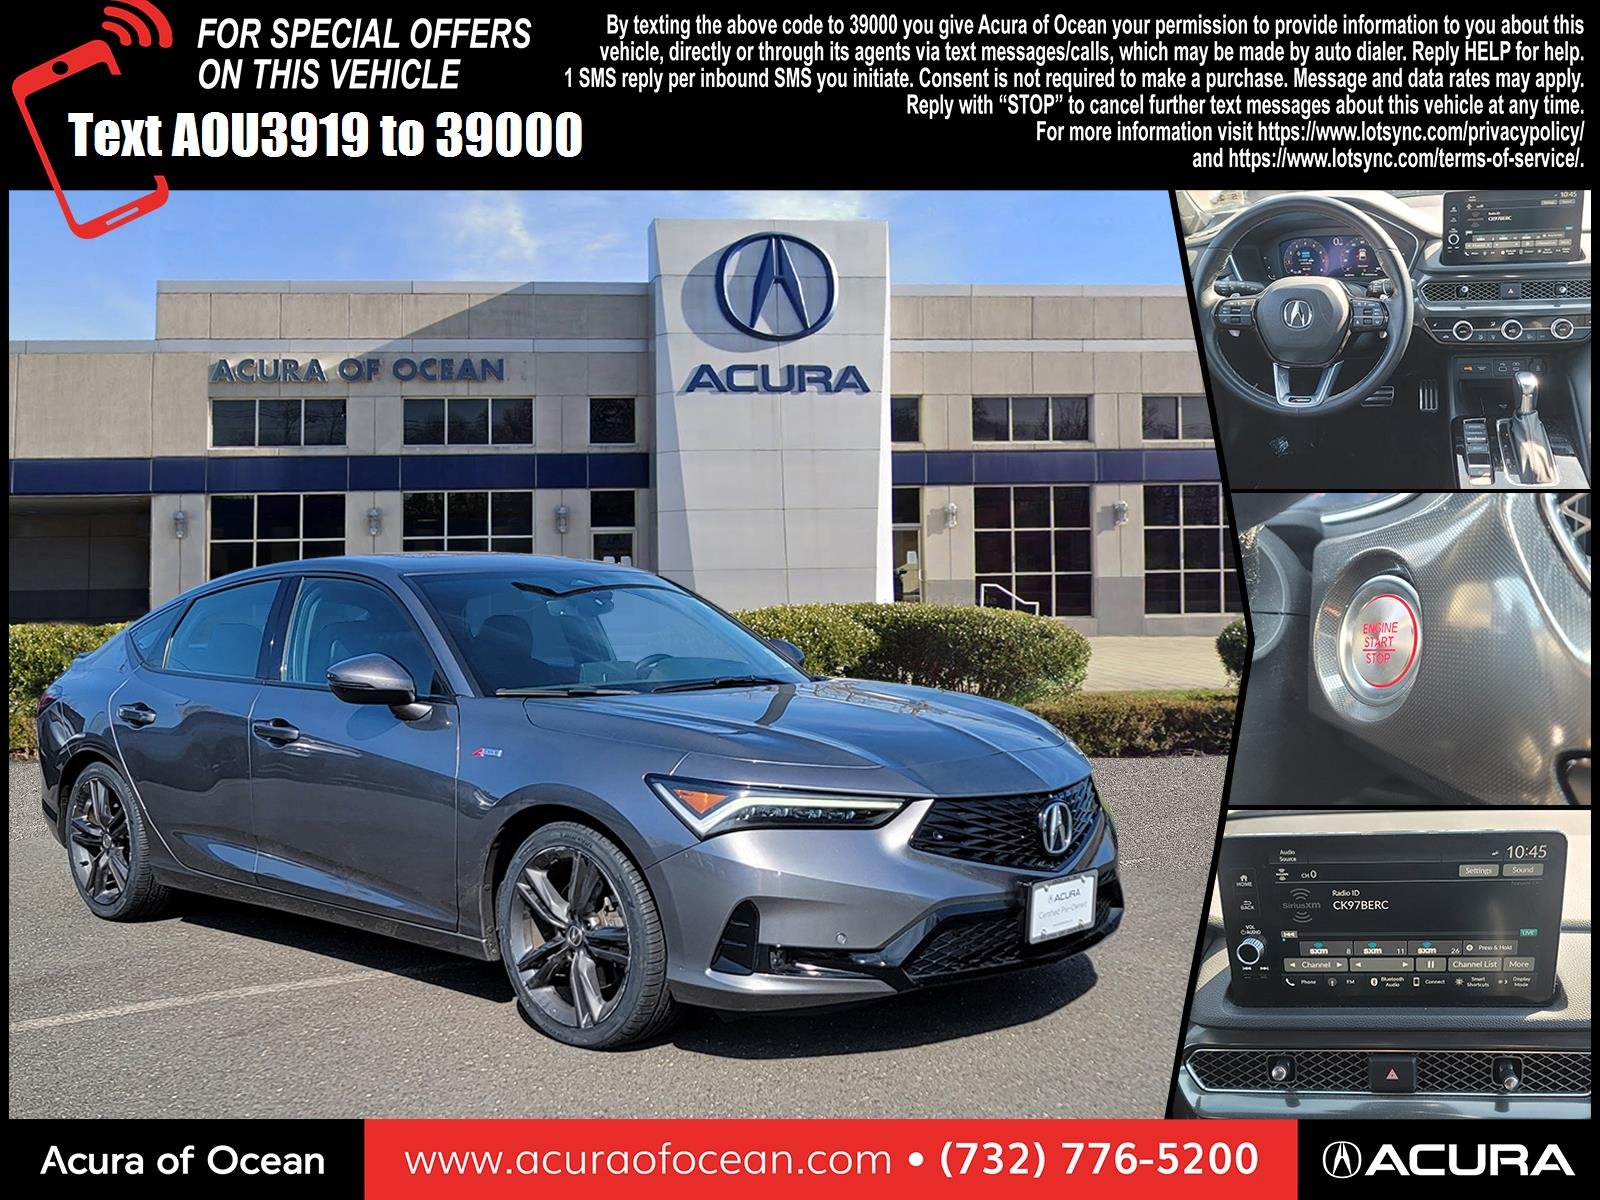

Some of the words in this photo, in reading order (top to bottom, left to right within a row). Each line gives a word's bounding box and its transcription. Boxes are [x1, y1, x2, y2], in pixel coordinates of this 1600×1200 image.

[209, 358, 327, 384] ACURA
[338, 357, 380, 383] OF
[392, 357, 505, 383] OCEAN
[685, 363, 871, 394] ACURA
[1363, 622, 1398, 634] ENGINE
[1364, 636, 1394, 648] START
[1366, 653, 1390, 665] STOP
[1507, 845, 1548, 859] 10:45
[1465, 867, 1493, 875] Settings
[1512, 866, 1534, 874] Sound
[1054, 888, 1081, 902] ACURA
[1351, 889, 1361, 897] ID
[1332, 900, 1390, 910] CK97BERC
[1301, 961, 1331, 969] Channel
[1452, 960, 1483, 968] Channel
[1485, 960, 1498, 968] List
[1509, 960, 1530, 968] More
